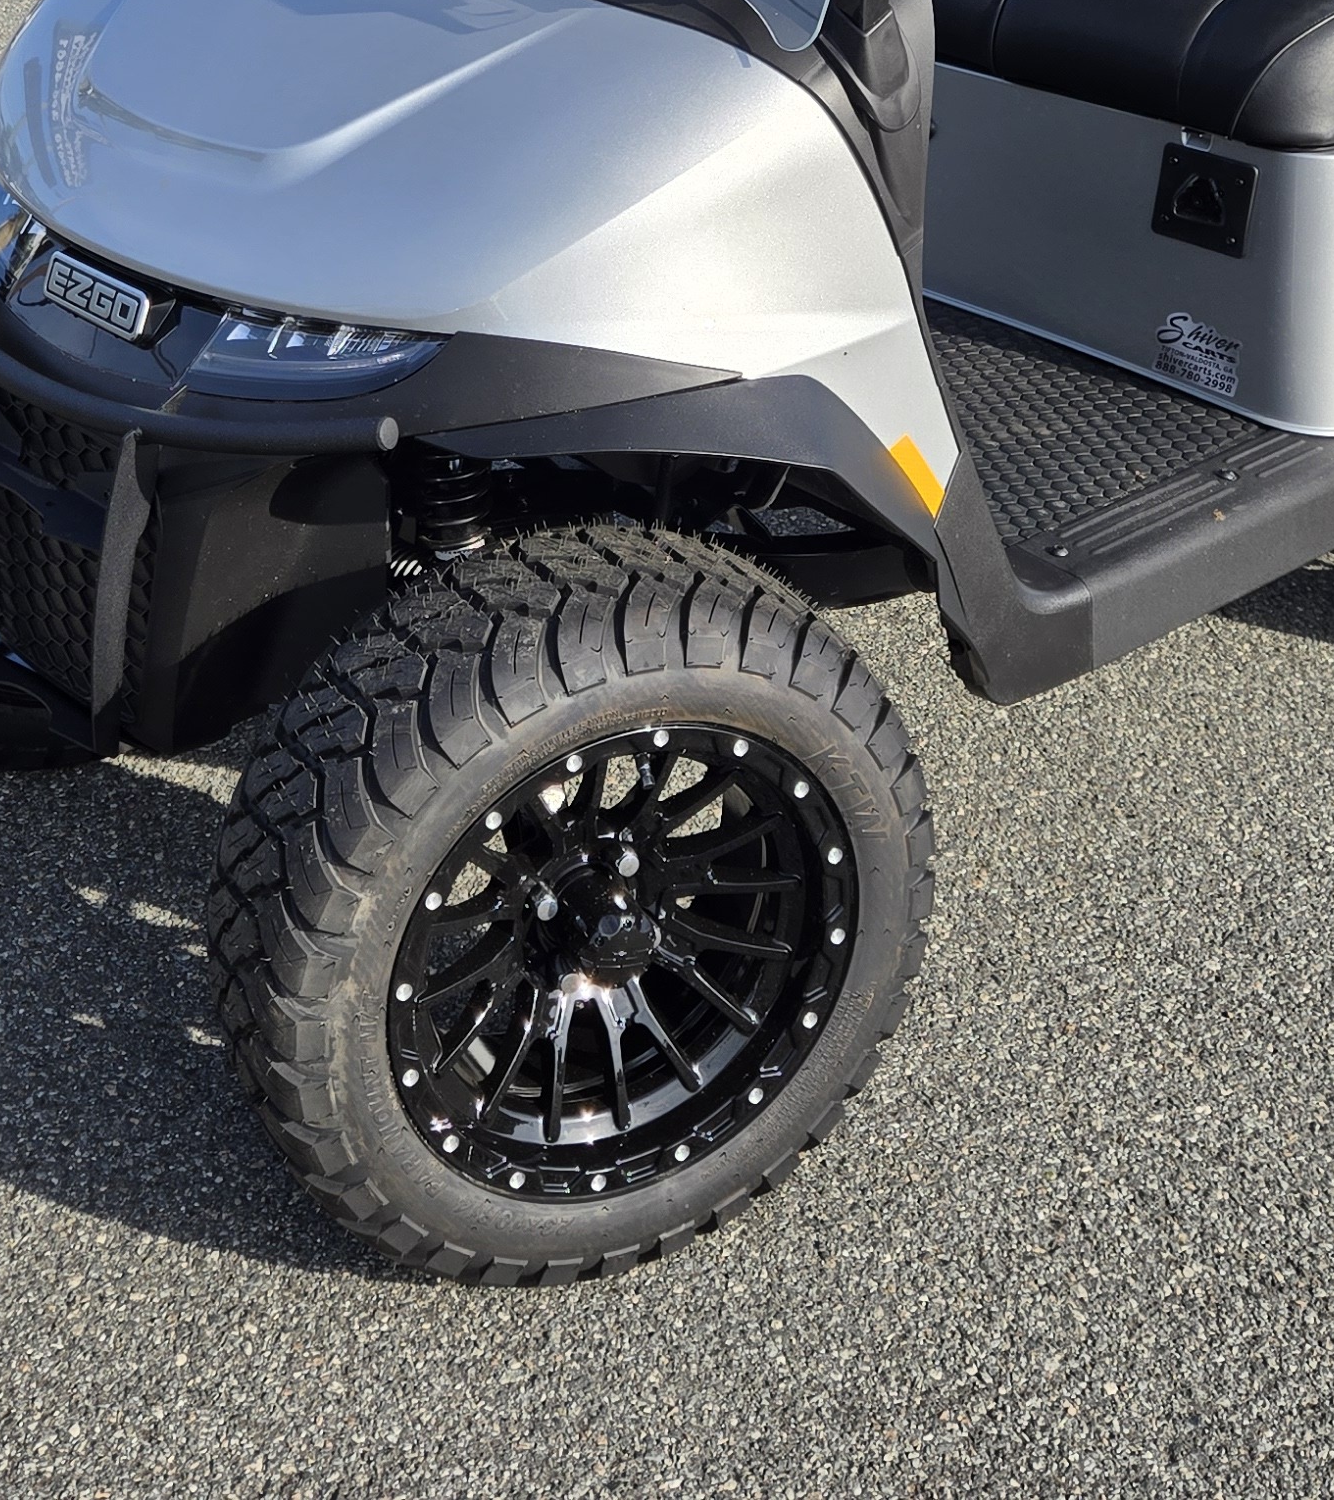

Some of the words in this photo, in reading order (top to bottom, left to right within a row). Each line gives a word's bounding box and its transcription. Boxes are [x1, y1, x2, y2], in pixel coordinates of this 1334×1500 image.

[48, 261, 139, 330] EZGO
[1156, 315, 1240, 352] Shiver
[1157, 352, 1236, 384] shivercarts.com
[1182, 341, 1237, 364] CARTS
[1223, 364, 1233, 374] GA
[1155, 360, 1233, 394] 888-780-2998
